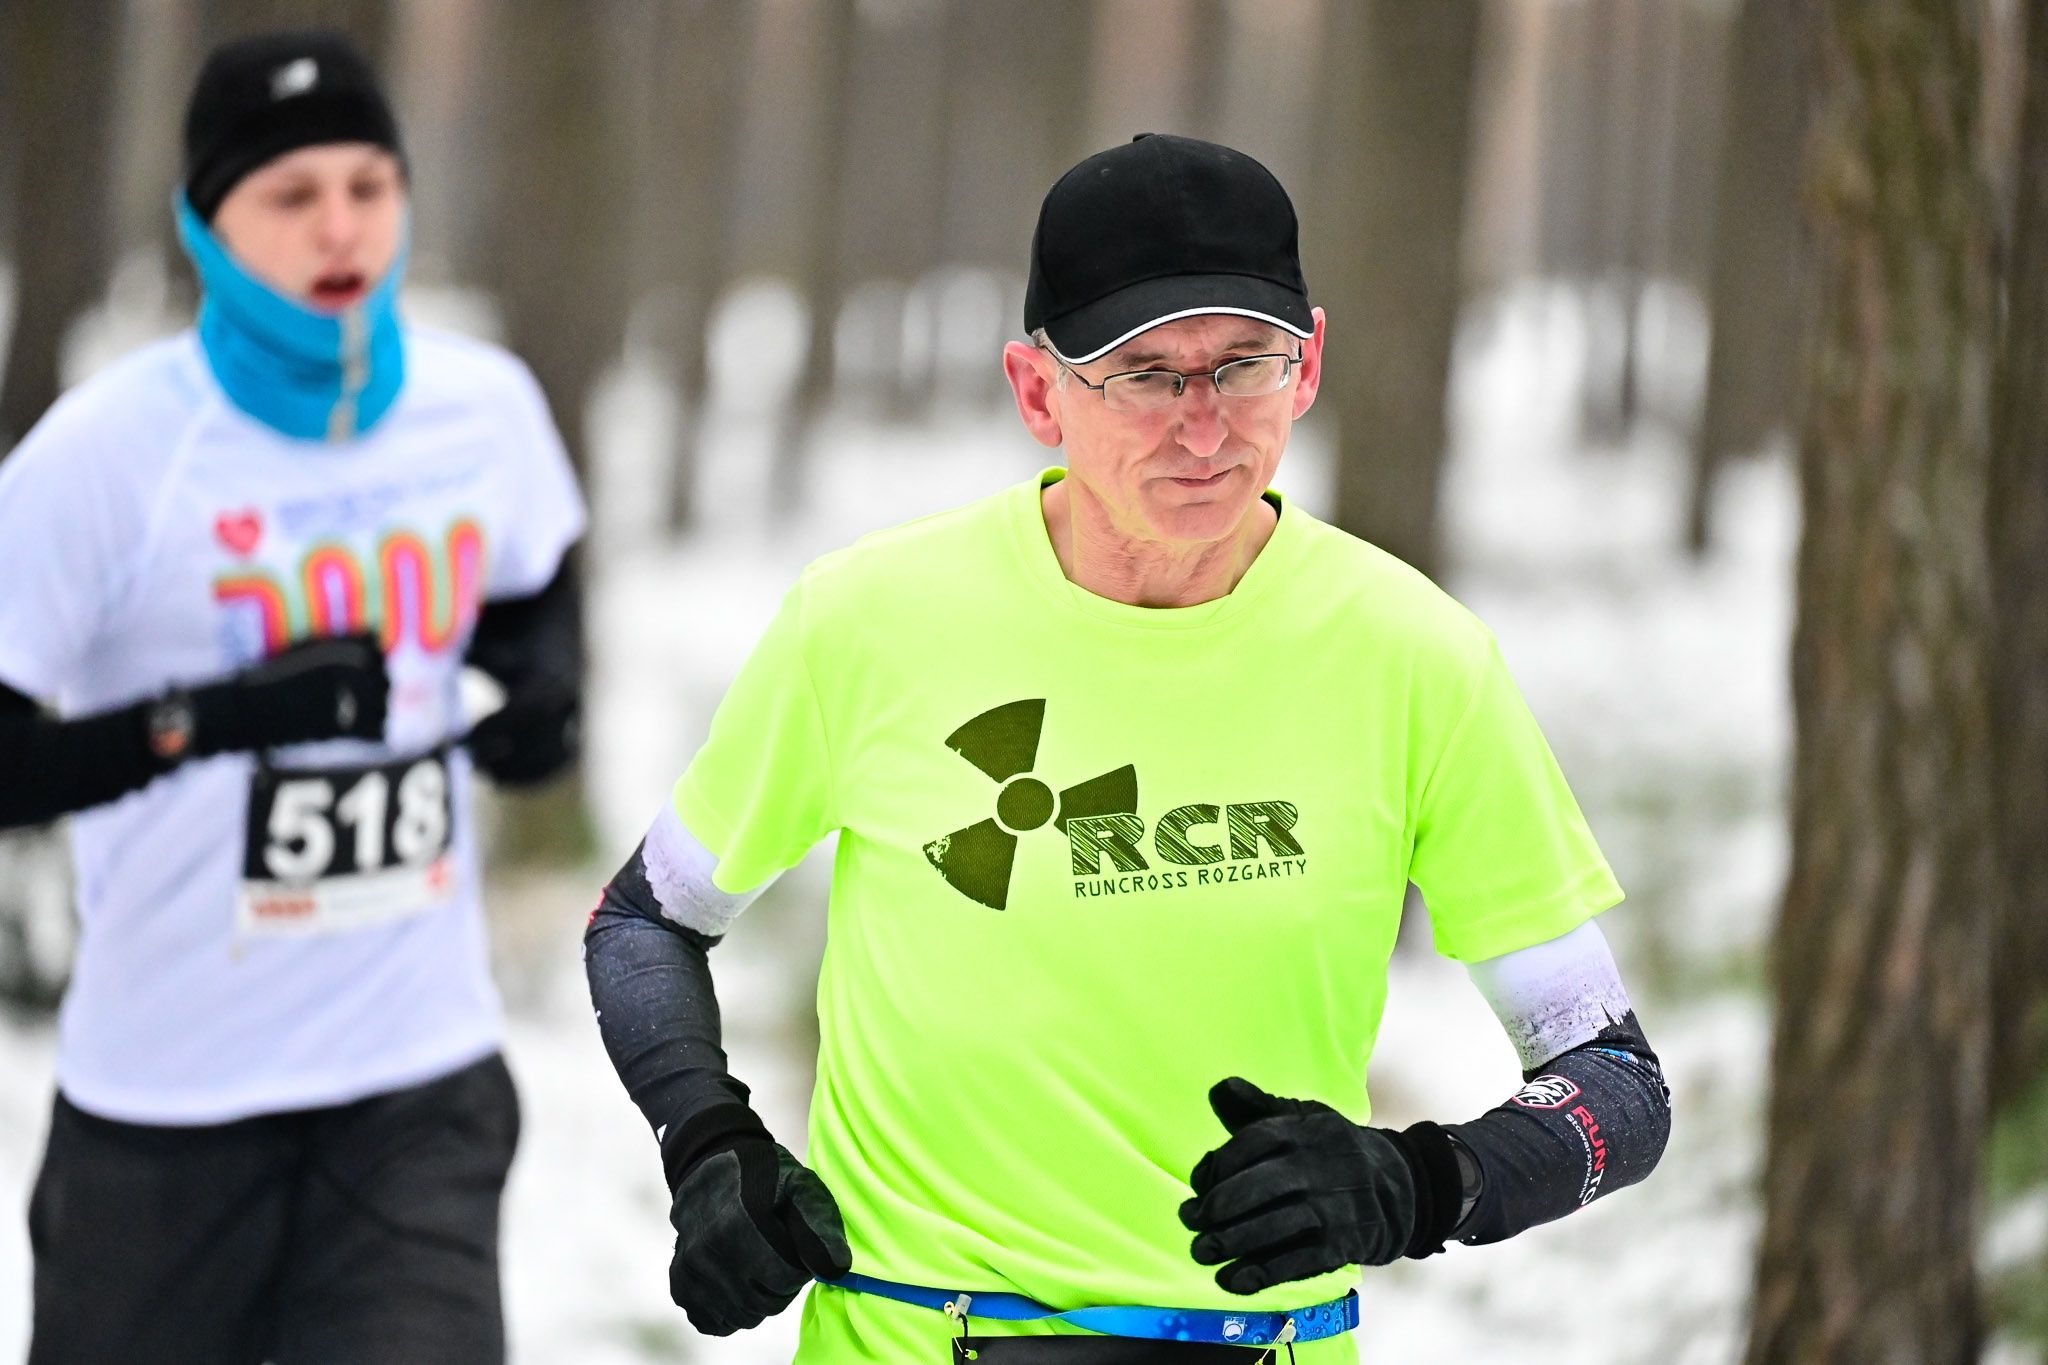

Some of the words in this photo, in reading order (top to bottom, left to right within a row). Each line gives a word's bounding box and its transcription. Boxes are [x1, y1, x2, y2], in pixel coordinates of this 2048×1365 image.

[262, 758, 448, 882] 518
[1067, 800, 1305, 875] RCR
[1074, 871, 1188, 898] RUNCROSS
[1198, 859, 1307, 885] ROZGARTY
